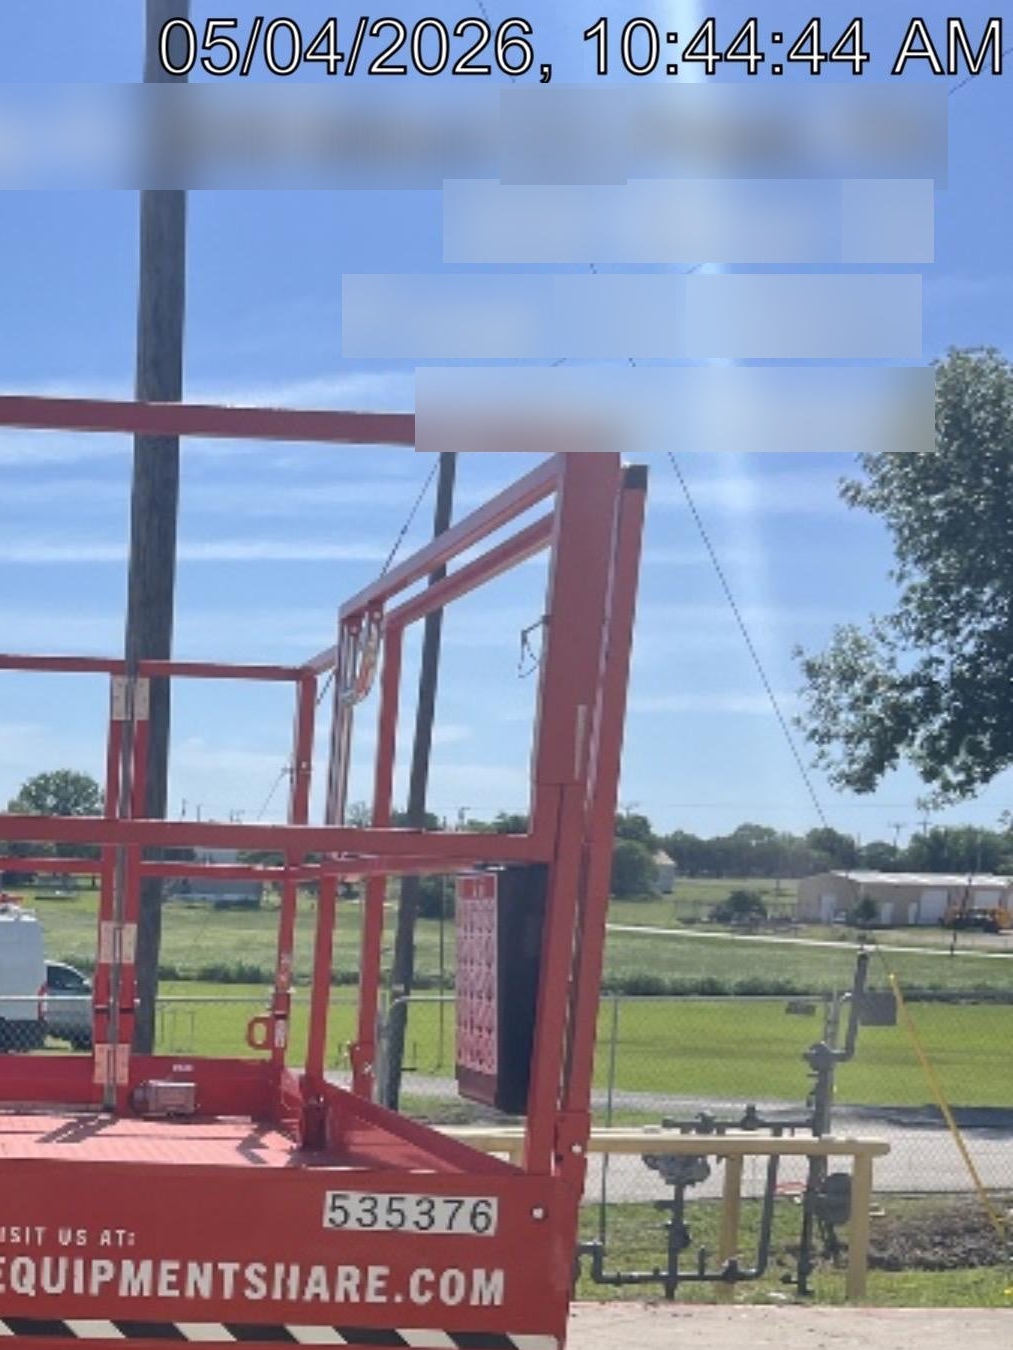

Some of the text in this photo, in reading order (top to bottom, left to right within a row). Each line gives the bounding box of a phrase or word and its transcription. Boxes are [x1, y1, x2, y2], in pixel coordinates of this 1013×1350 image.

[326, 1193, 495, 1234] 535376
[58, 1227, 88, 1246] US
[99, 1228, 136, 1246] AT:
